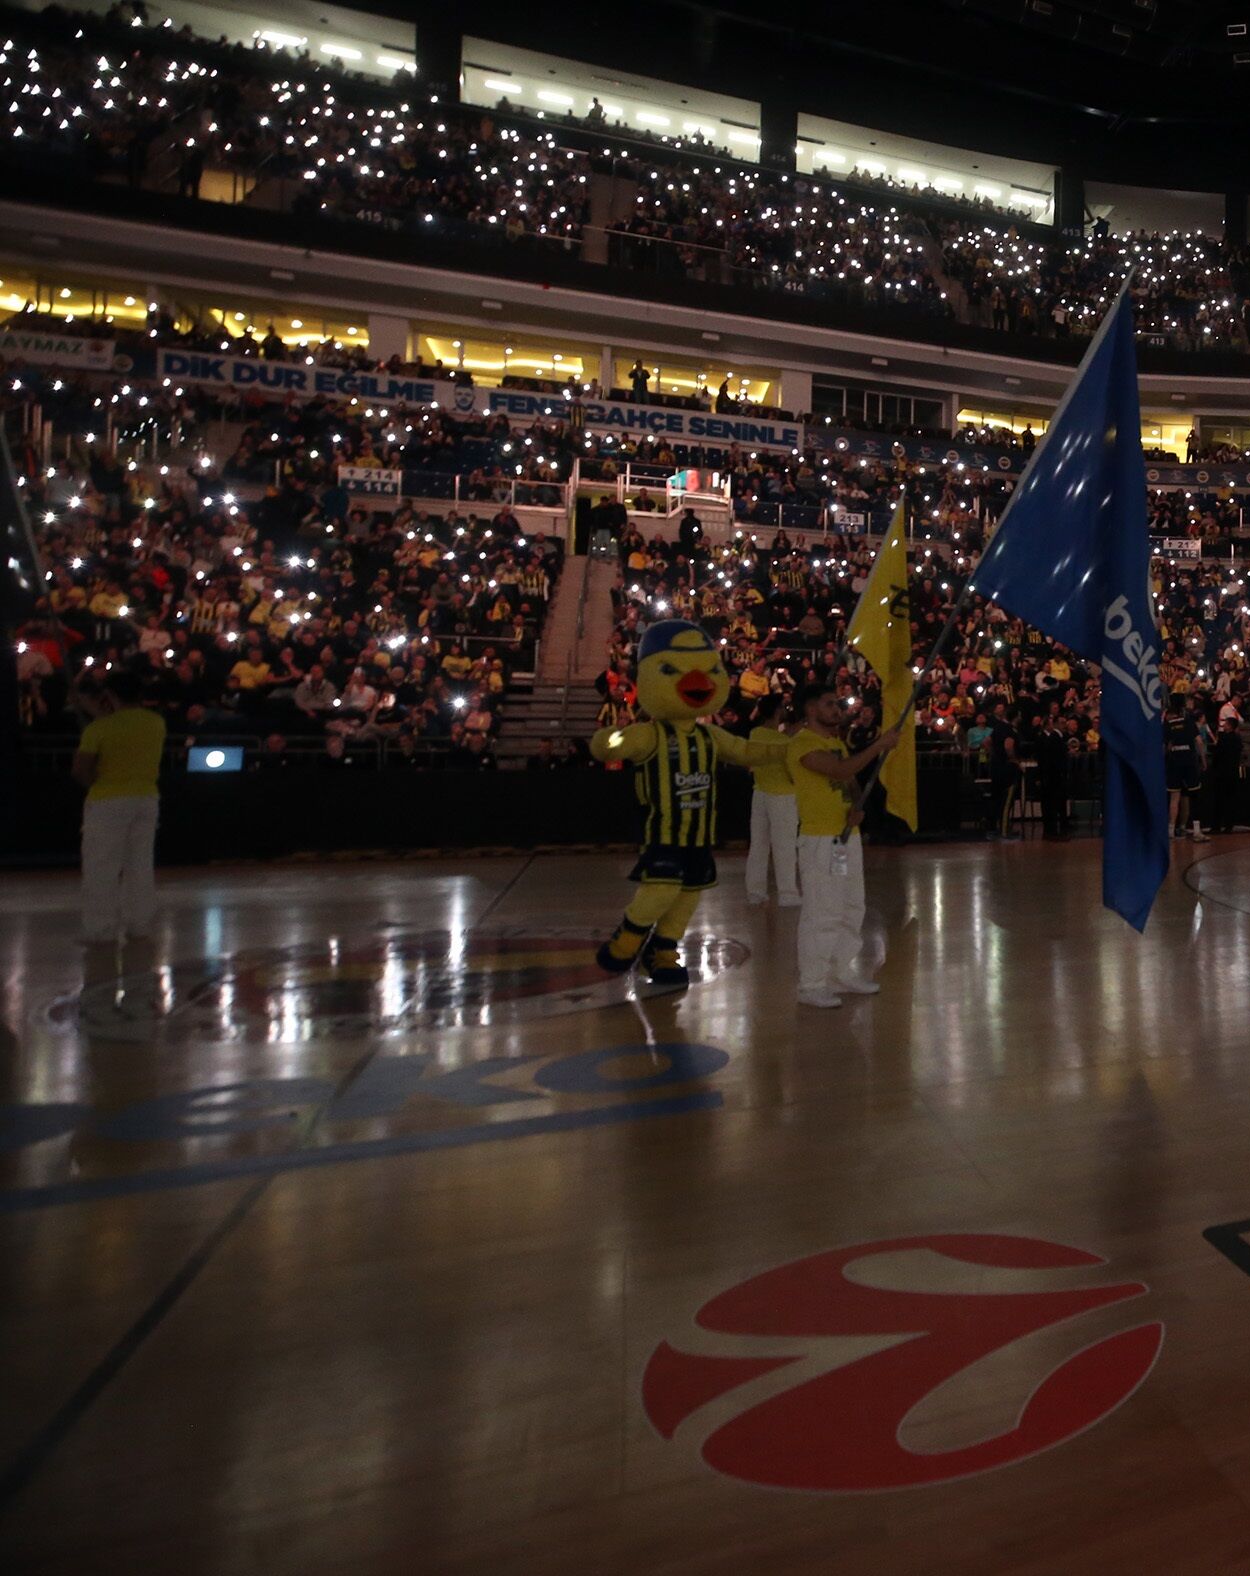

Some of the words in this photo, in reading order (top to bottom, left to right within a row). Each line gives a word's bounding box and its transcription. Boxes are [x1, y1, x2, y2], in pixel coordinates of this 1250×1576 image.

[784, 281, 804, 292] 414
[1149, 337, 1165, 345] 413
[232, 362, 307, 390] DUR
[489, 392, 683, 434] FENEBAHÇE
[364, 469, 393, 480] 214
[364, 481, 394, 492] 114
[840, 514, 859, 522] 213
[1178, 550, 1197, 558] 112
[674, 771, 711, 787] beko
